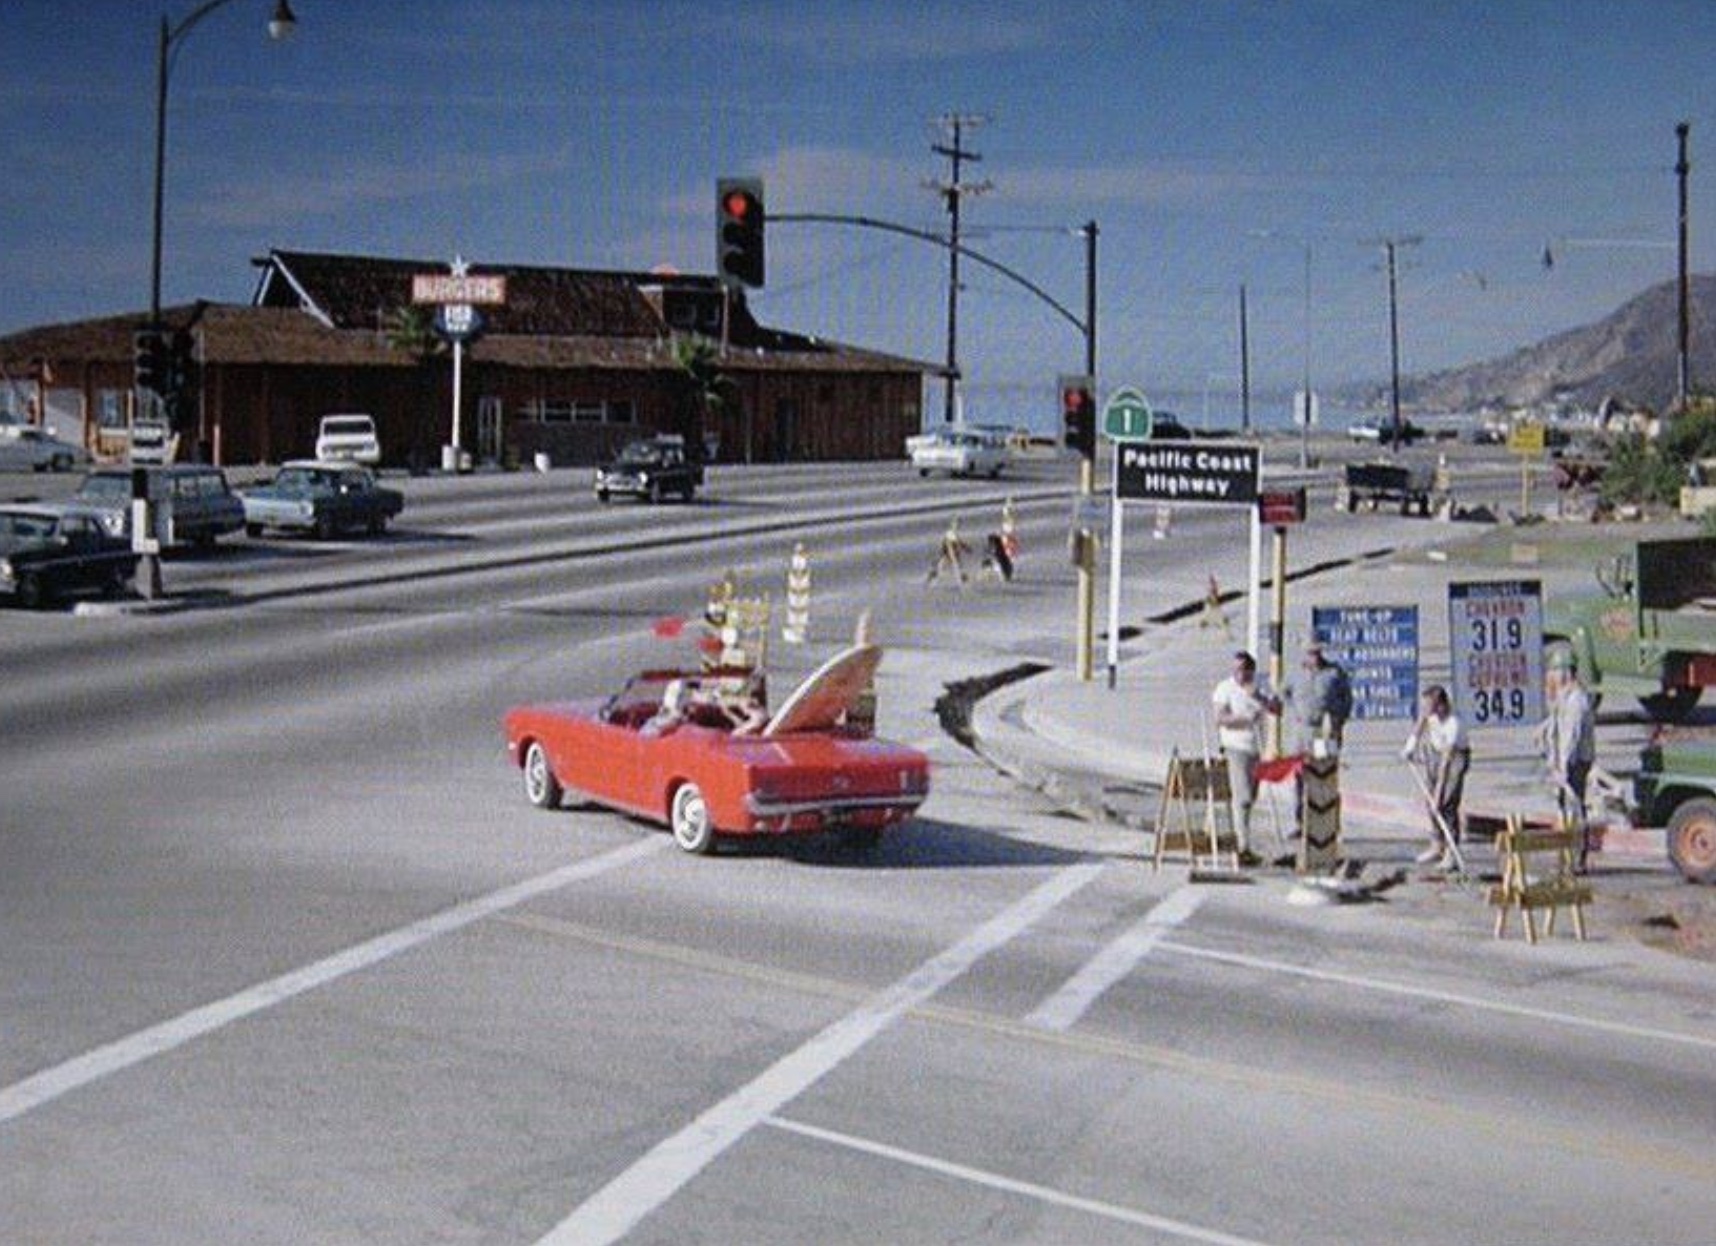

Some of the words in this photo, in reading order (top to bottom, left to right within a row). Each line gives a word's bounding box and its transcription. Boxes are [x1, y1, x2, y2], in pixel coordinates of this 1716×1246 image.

[1123, 408, 1131, 432] 1
[1124, 449, 1192, 469] Pacific
[1197, 451, 1251, 471] Coast
[1145, 473, 1230, 496] Highway
[1472, 617, 1522, 651] 31.9
[1474, 687, 1525, 722] 34.9
